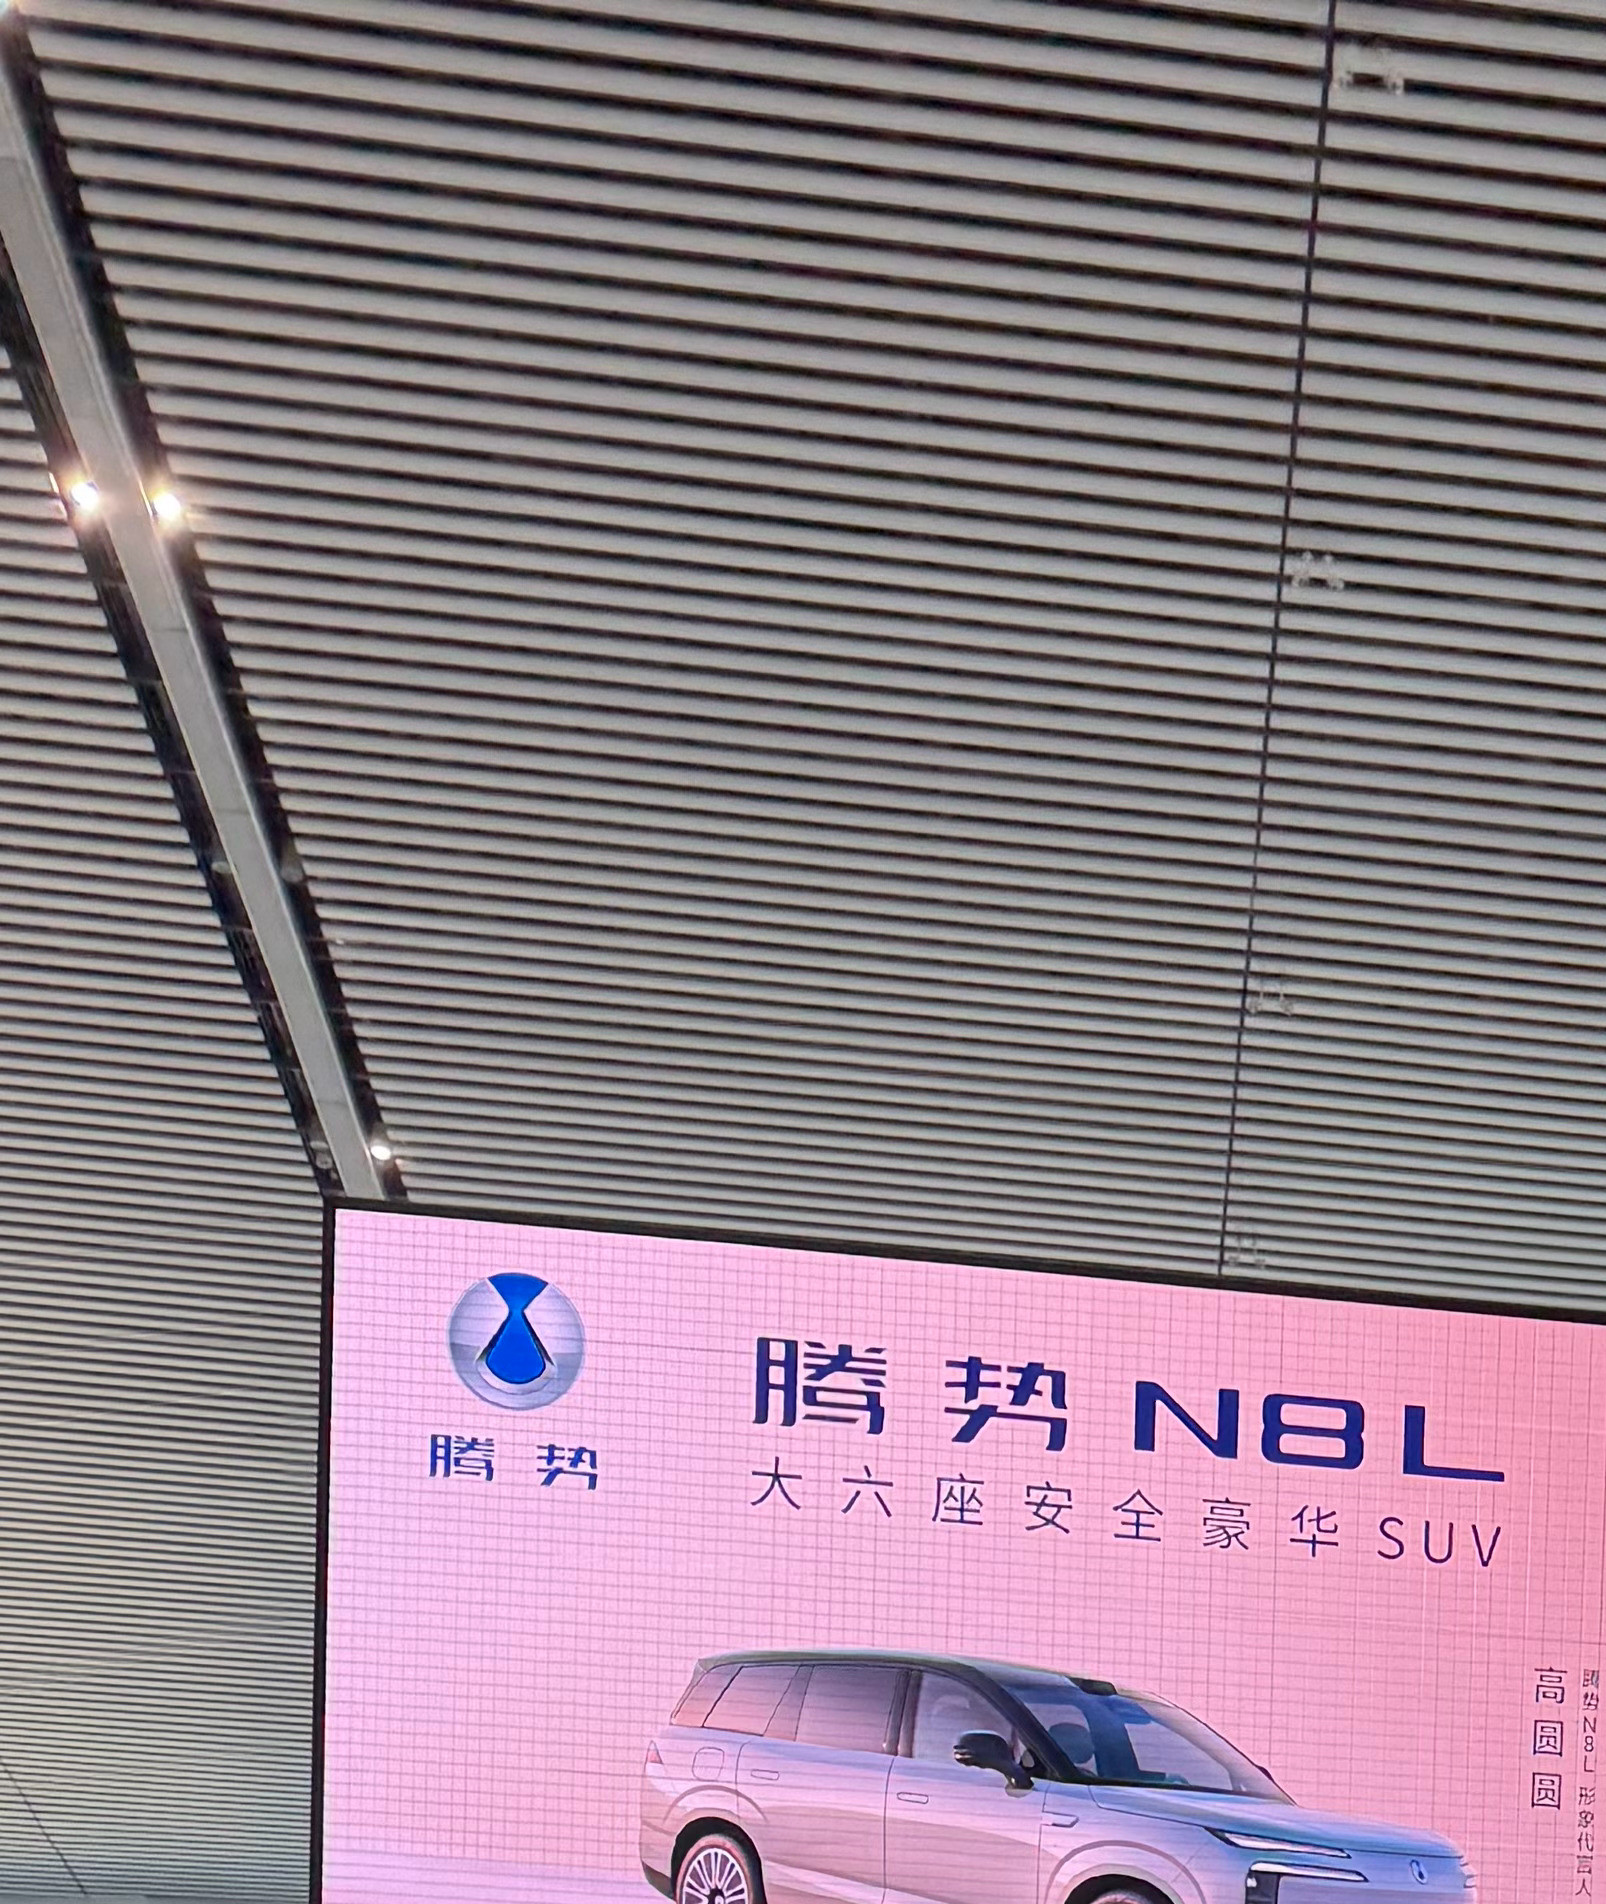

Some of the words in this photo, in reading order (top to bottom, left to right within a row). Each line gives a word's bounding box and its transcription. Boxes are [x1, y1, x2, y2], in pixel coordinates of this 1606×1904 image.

[429, 1434, 598, 1490] 腾势
[751, 1336, 1067, 1451] 腾势
[1134, 1380, 1505, 1483] N8L
[1531, 1667, 1567, 1810] 高圆圆
